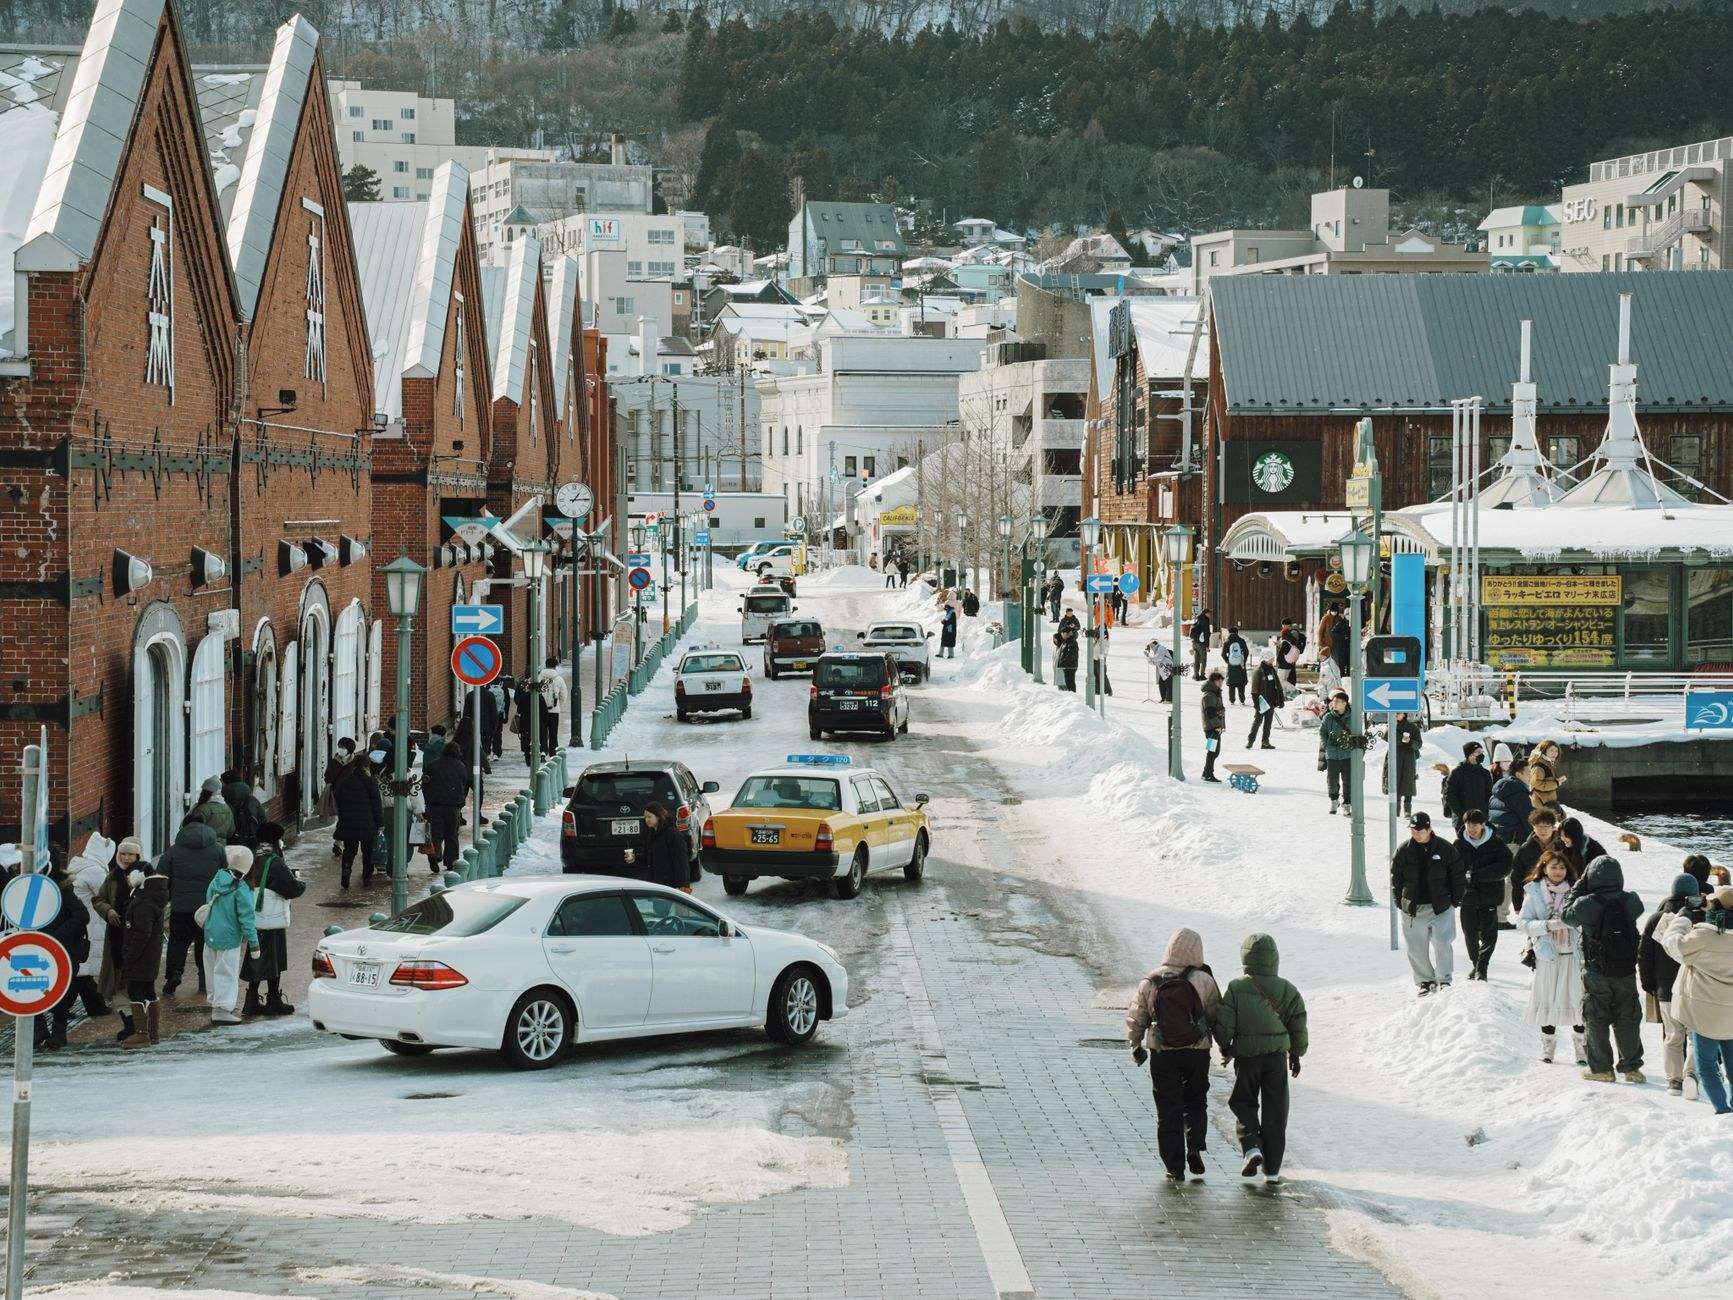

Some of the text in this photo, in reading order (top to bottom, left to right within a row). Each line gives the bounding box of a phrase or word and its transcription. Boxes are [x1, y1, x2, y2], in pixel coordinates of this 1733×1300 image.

[1564, 198, 1594, 222] SEC
[594, 221, 612, 233] hif
[1503, 590, 1561, 599] ラッキーピエロ
[1488, 631, 1613, 645] ゆったりゆっくり154席
